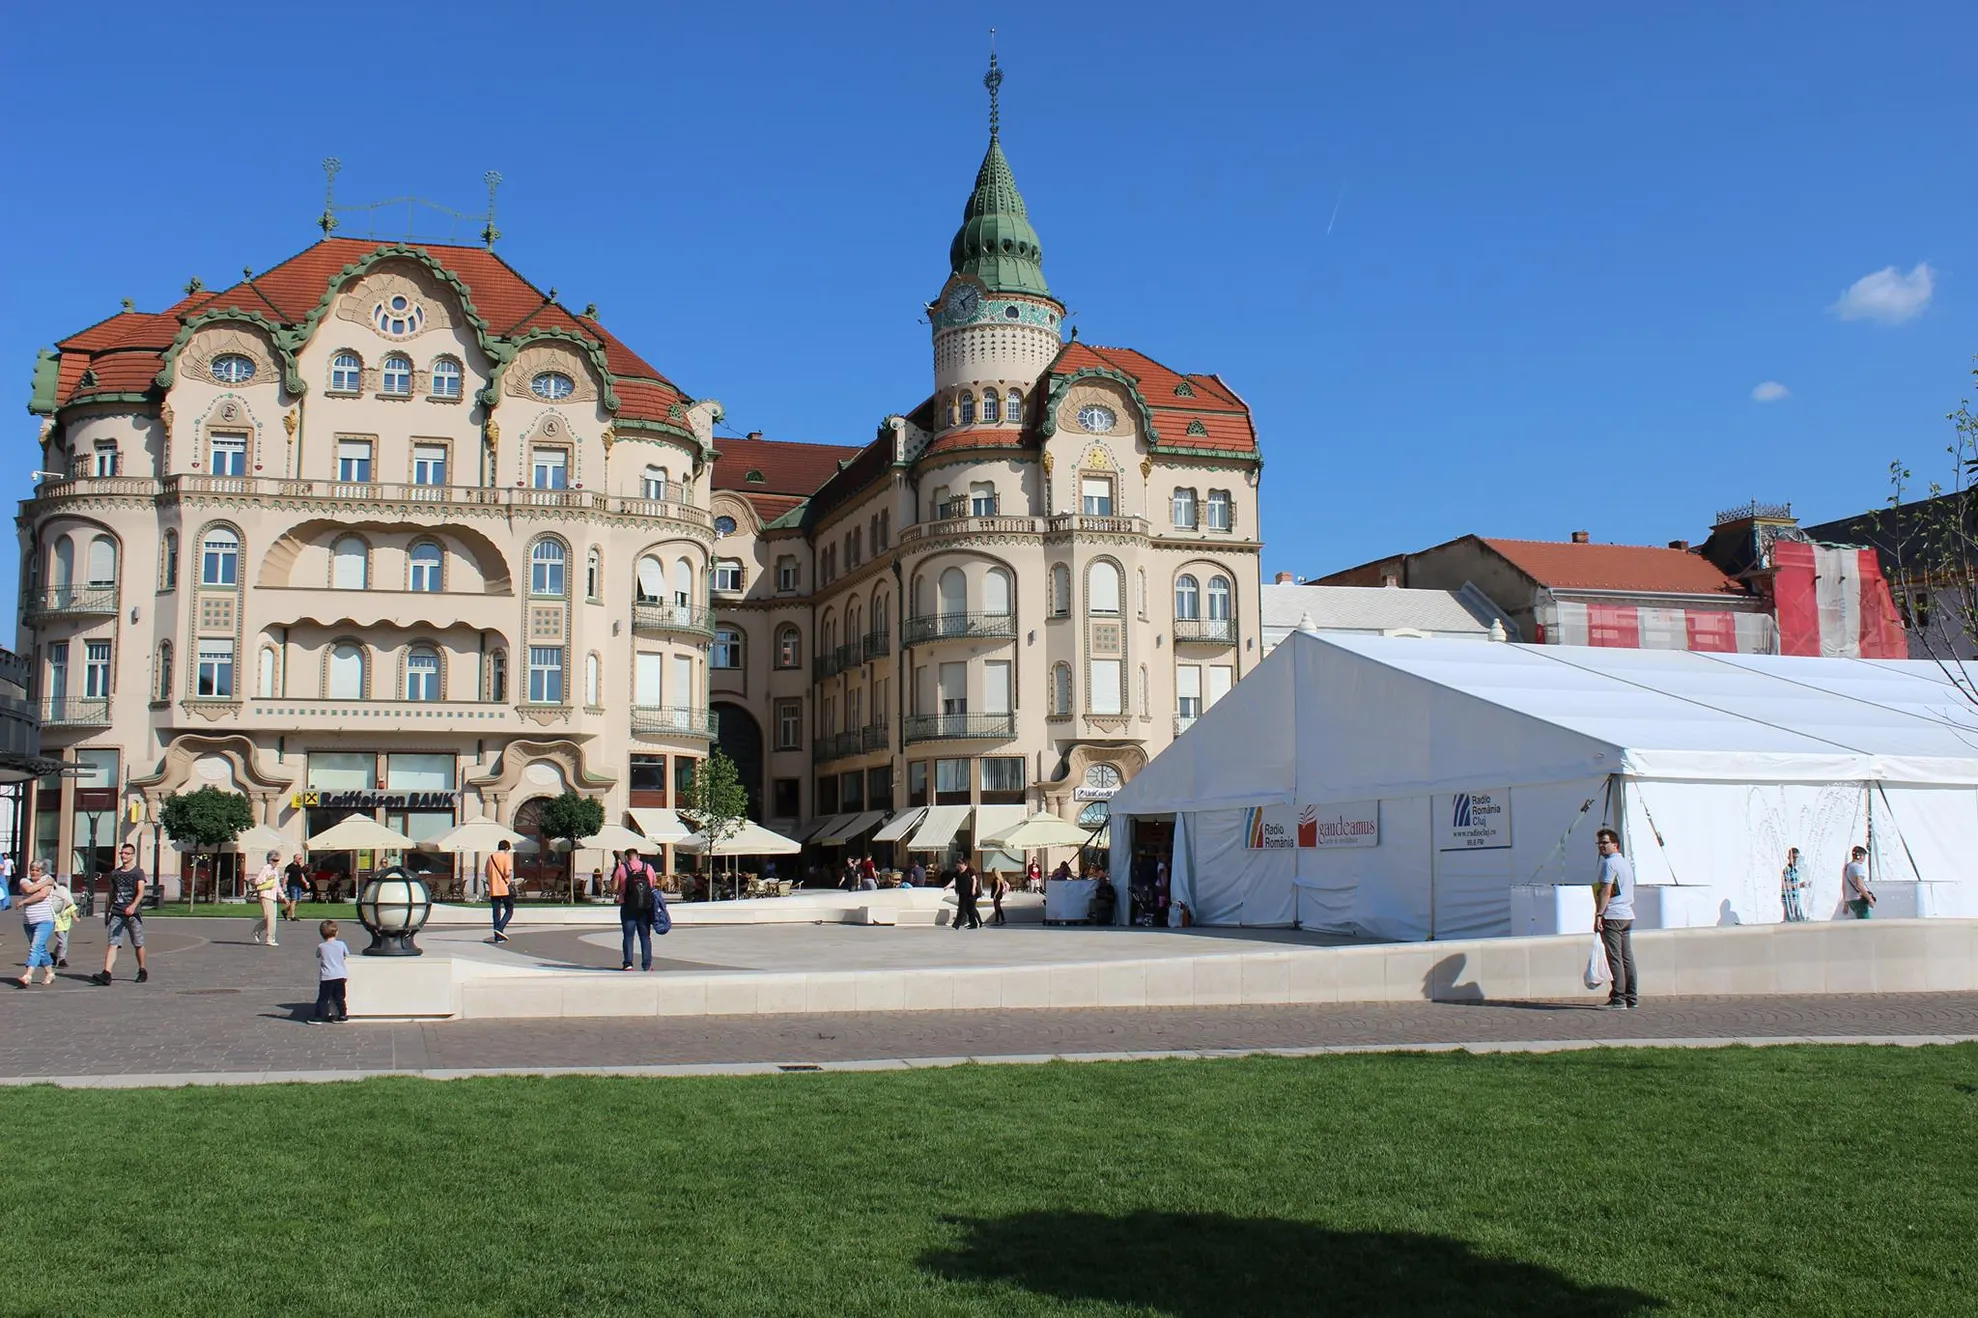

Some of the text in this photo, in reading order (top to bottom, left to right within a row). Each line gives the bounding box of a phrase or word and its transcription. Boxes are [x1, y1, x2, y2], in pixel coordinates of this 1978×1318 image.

[320, 790, 456, 807] Raiffeisen BANK
[1472, 795, 1490, 805] Radio
[1472, 804, 1501, 815] România
[1473, 816, 1486, 827] Cluj
[1265, 824, 1284, 835] Radio
[1318, 815, 1375, 845] gaudeamus
[1265, 836, 1294, 848] România
